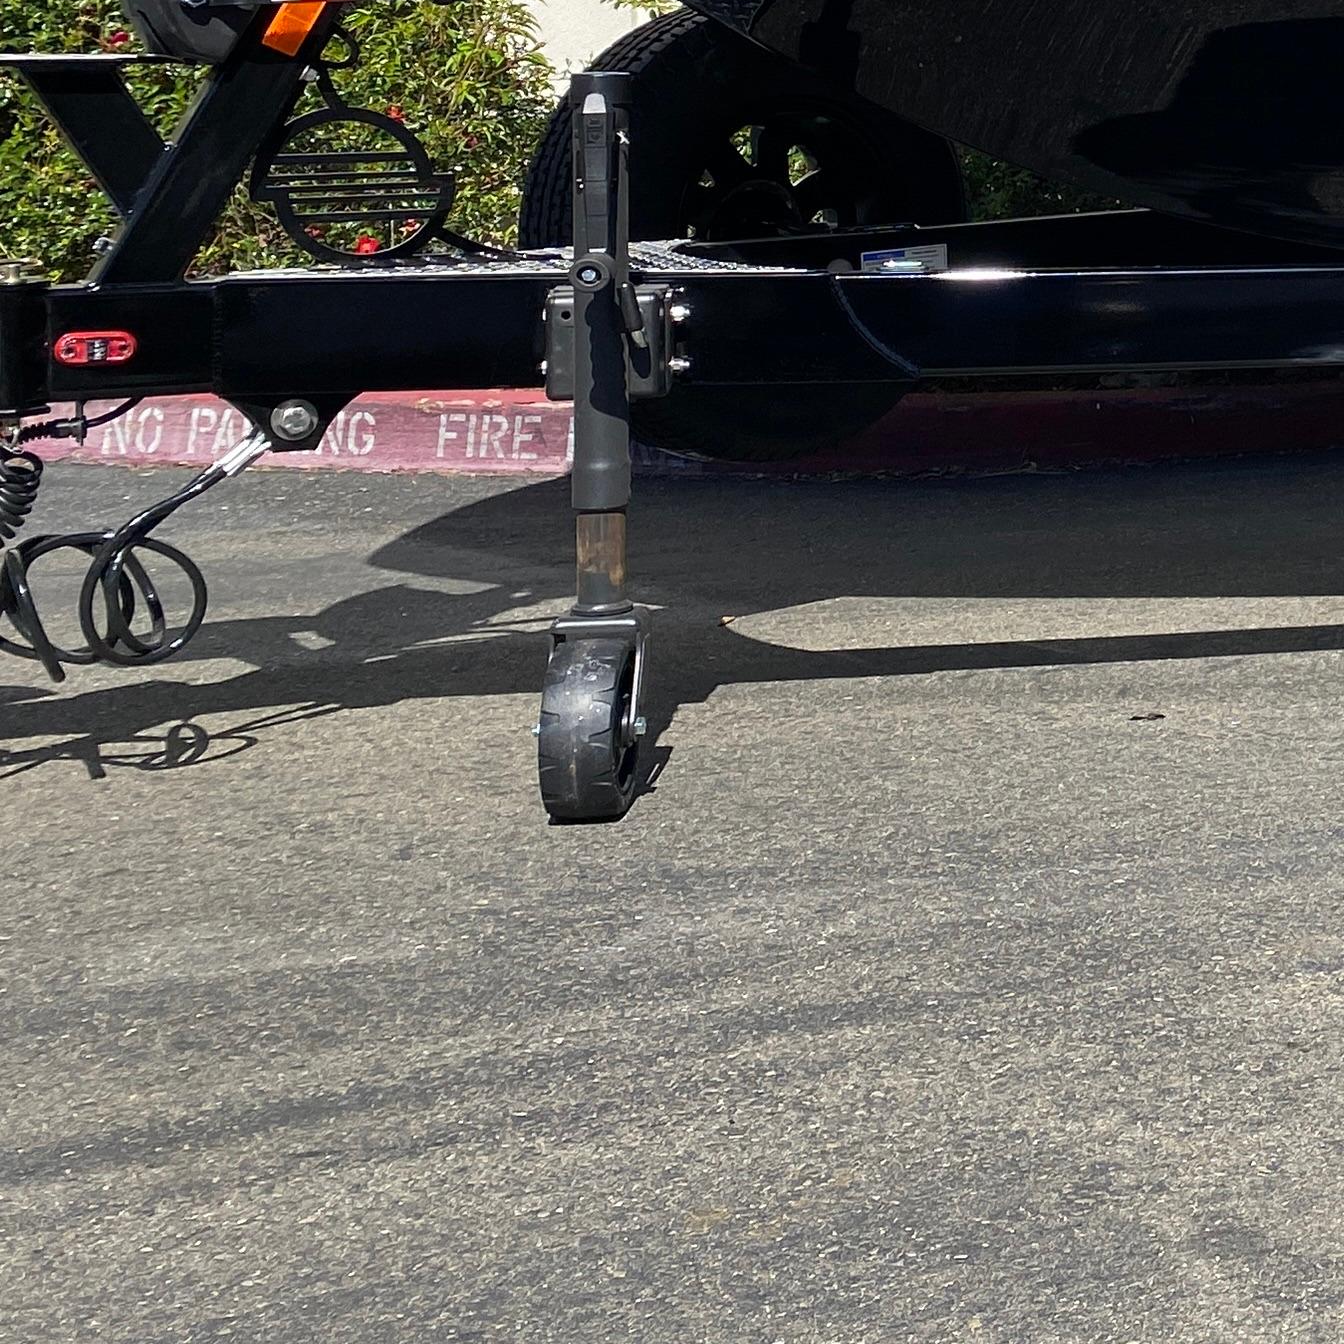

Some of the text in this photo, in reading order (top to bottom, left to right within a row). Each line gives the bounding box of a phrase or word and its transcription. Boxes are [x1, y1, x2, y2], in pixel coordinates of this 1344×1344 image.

[101, 406, 164, 456] NO
[186, 407, 377, 456] PANG
[436, 413, 542, 460] FIRE
